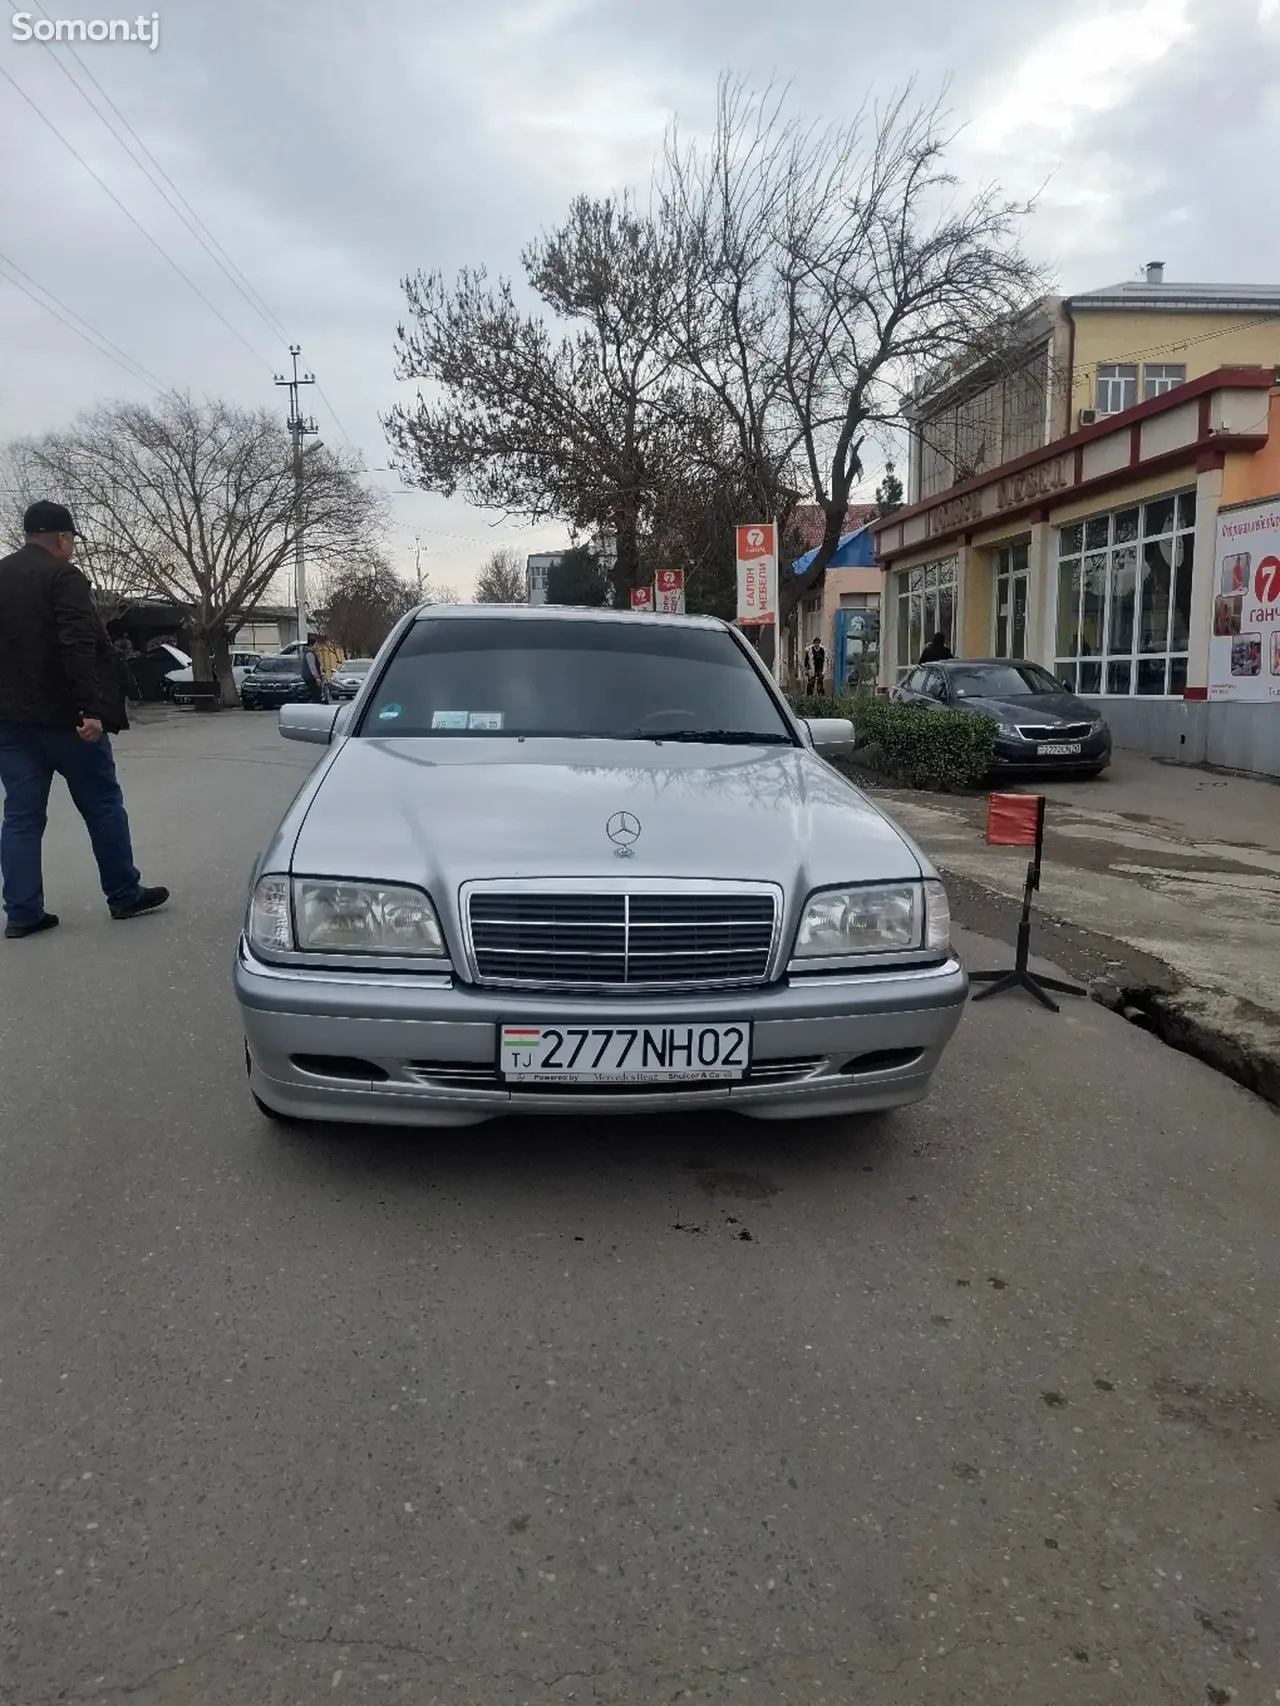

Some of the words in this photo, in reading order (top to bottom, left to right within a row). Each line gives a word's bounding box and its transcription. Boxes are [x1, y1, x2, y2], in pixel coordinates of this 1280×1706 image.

[746, 567, 755, 607] САЛОН
[758, 562, 767, 610] МЕБЕЛИ
[512, 1053, 532, 1067] TJ
[541, 1027, 744, 1068] 2777NH02
[569, 1074, 579, 1082] by
